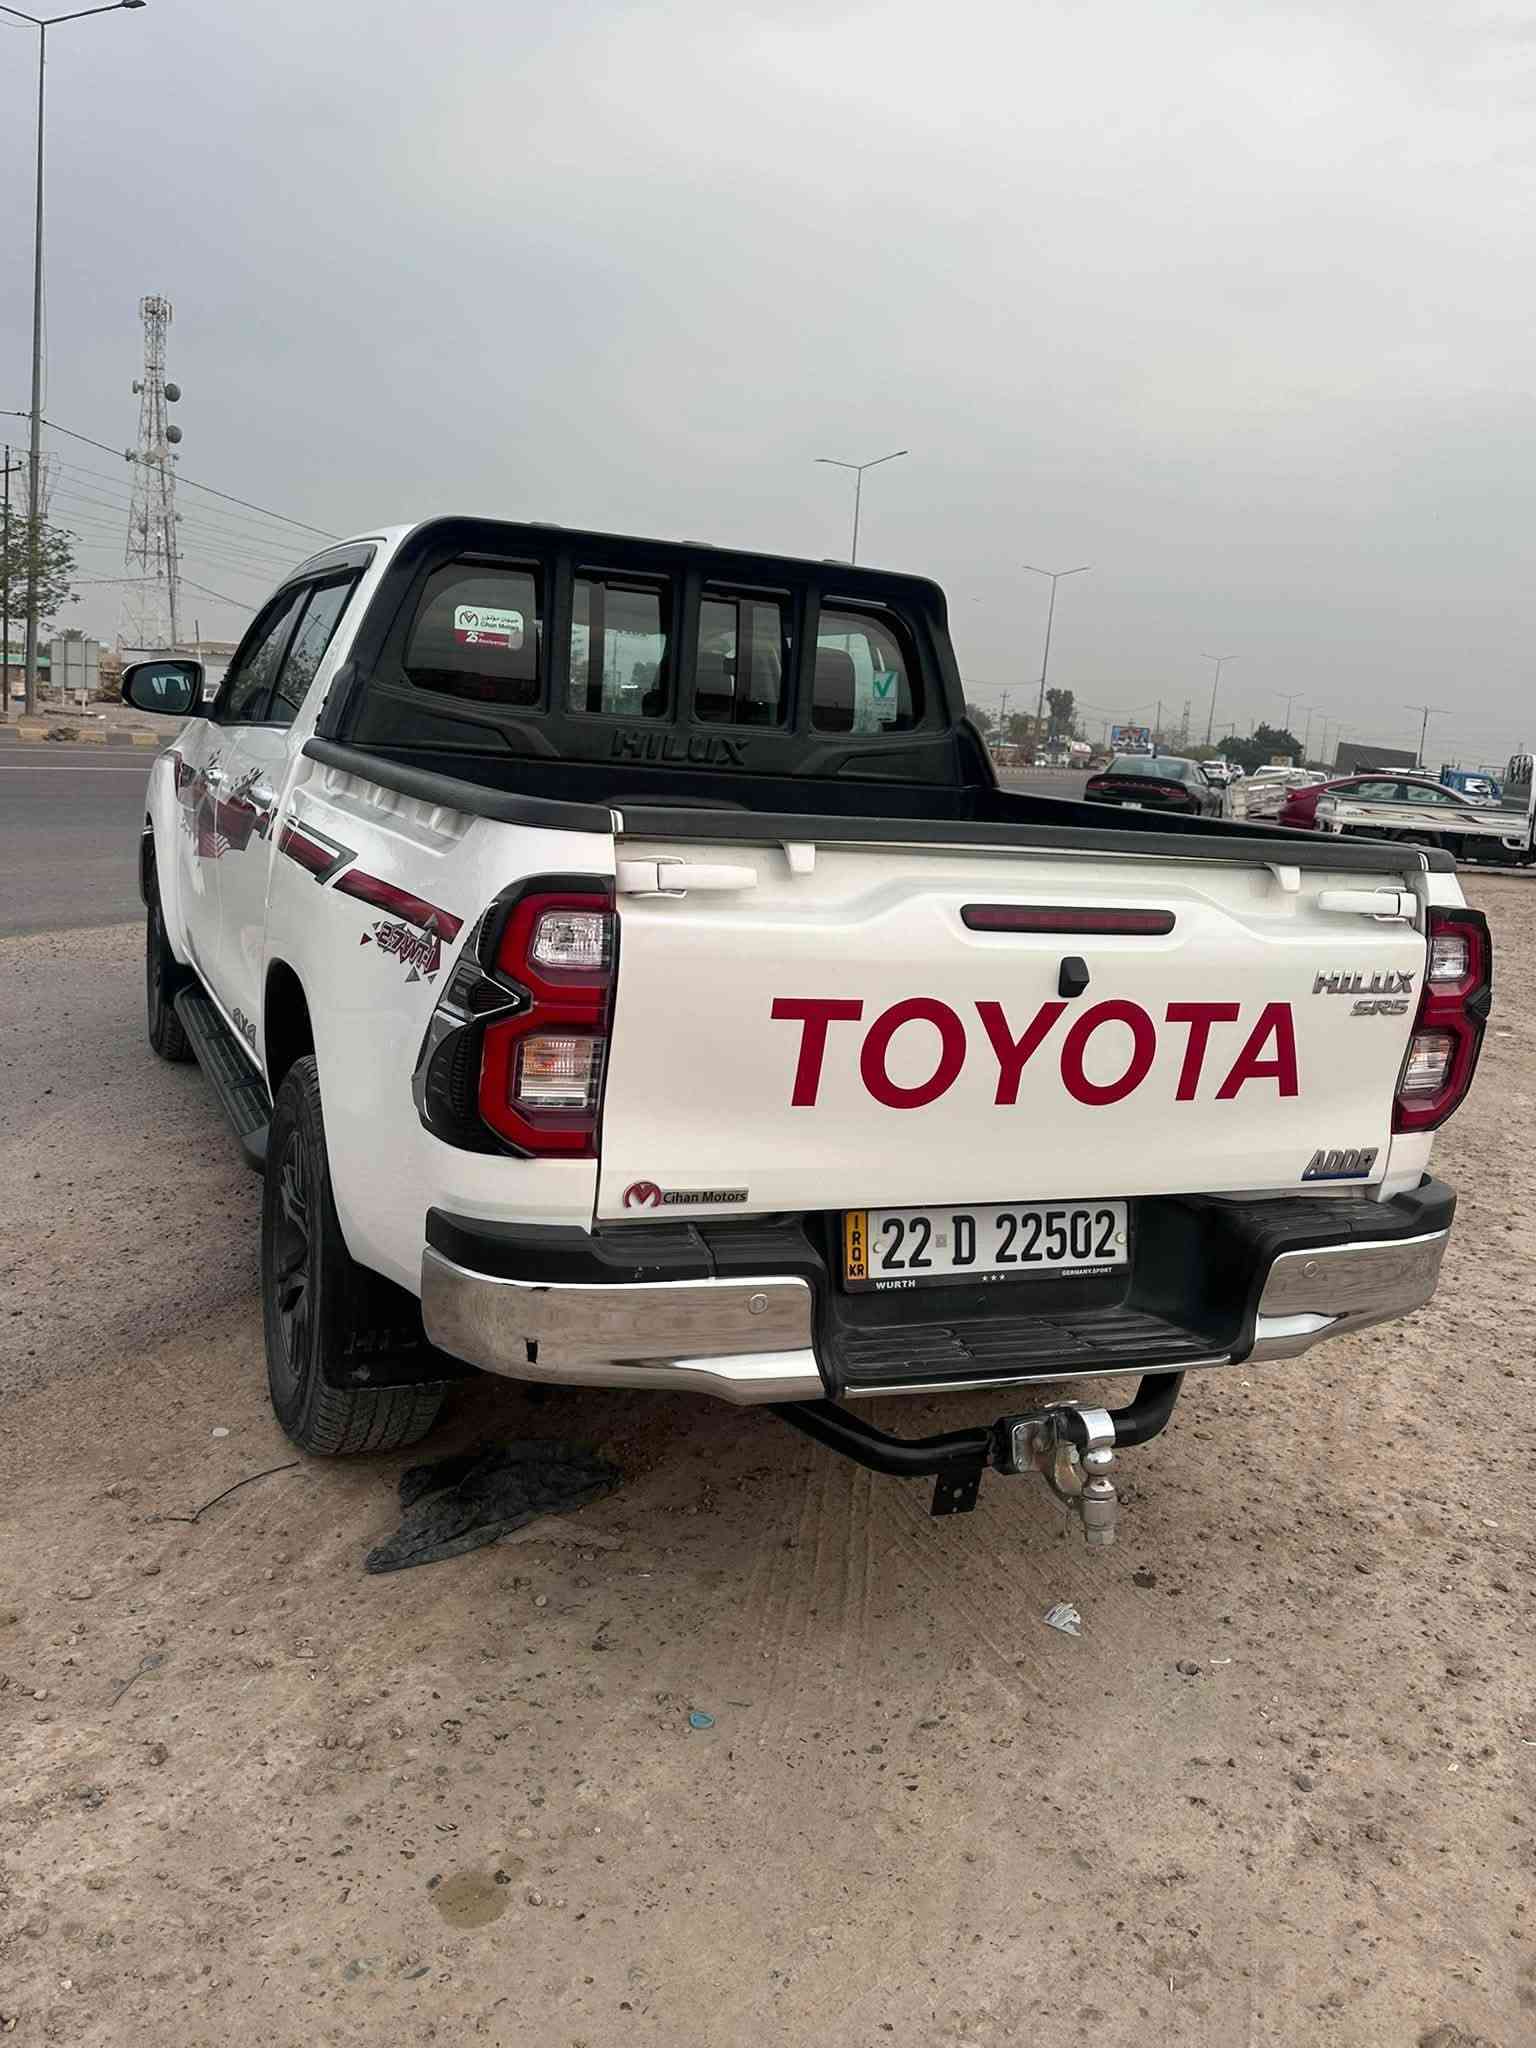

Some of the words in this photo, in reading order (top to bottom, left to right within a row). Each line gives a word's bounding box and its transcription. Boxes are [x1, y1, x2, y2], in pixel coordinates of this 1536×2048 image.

[608, 729, 749, 766] HILUX
[1311, 968, 1416, 994] HILUX
[1350, 1000, 1410, 1016] SR5
[771, 997, 1299, 1109] TOYOTA
[663, 1191, 699, 1204] Cihan
[702, 1190, 748, 1203] Motors
[881, 1216, 932, 1270] 22
[951, 1214, 977, 1266] D
[995, 1208, 1117, 1264] 22502
